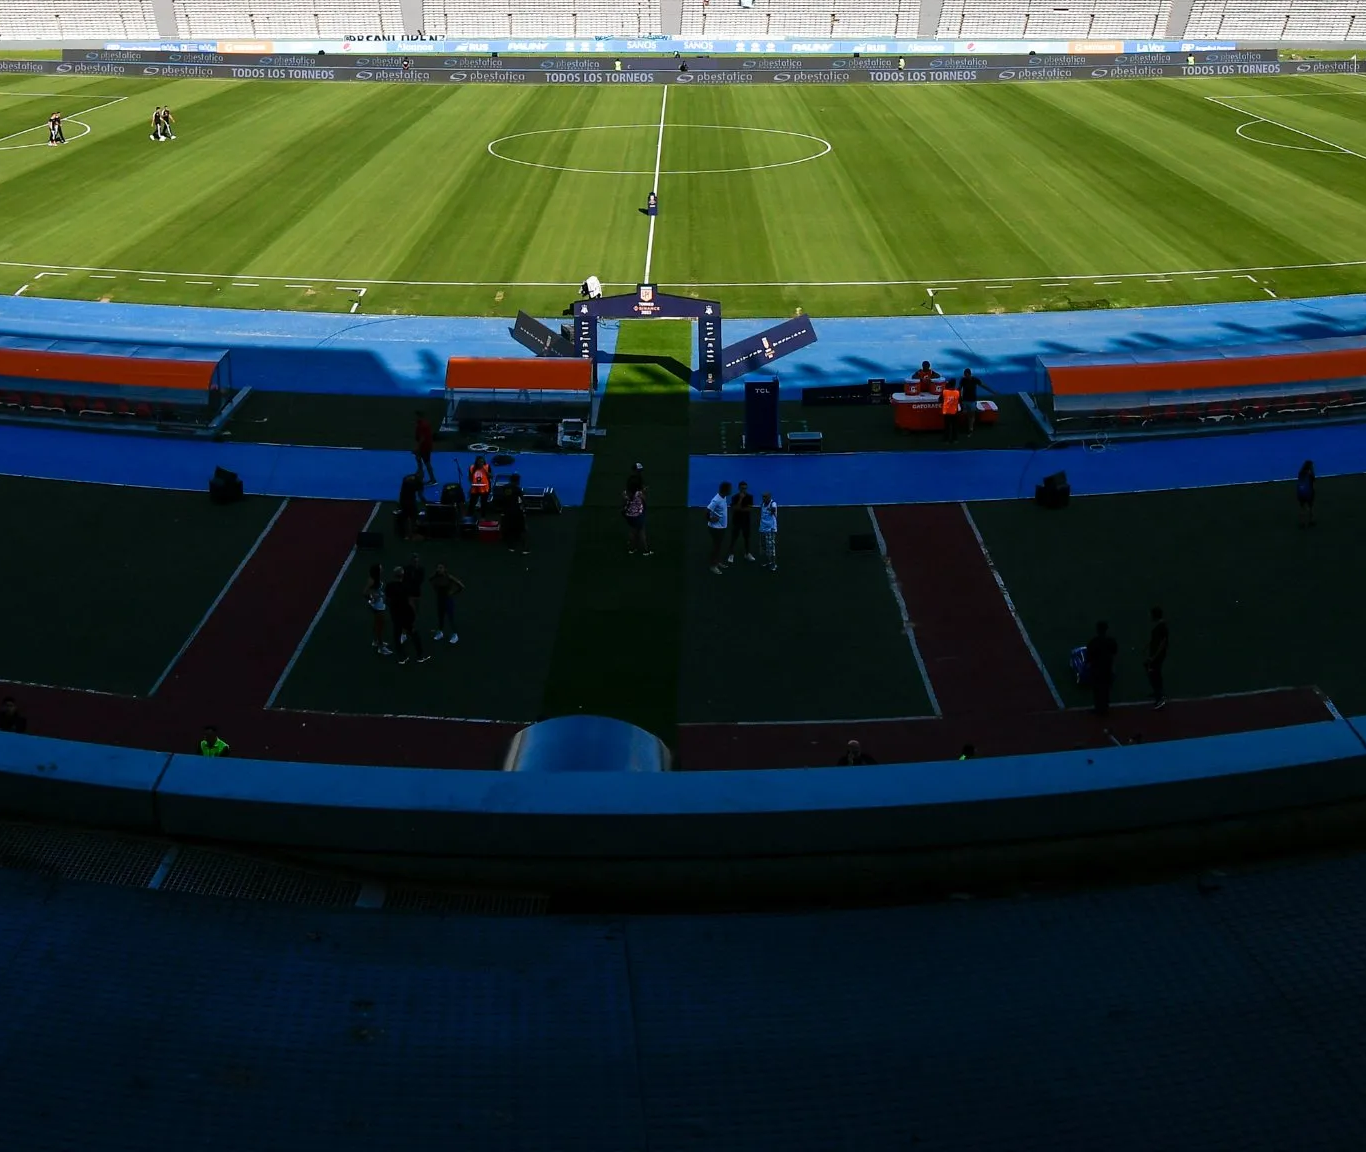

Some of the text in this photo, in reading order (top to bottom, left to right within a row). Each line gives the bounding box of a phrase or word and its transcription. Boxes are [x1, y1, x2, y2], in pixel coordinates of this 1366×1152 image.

[626, 40, 657, 50] SANOS
[683, 40, 714, 50] SANOS
[74, 62, 125, 74] pbestatica
[161, 64, 213, 76] pbestatica
[231, 67, 335, 80] TODOS LOS TORNEOS
[1018, 68, 1072, 79] pbestatica
[1110, 66, 1163, 78] pbestatica
[1181, 62, 1281, 76] TODOS LOS TORNEOS
[374, 69, 430, 81] pbestatica
[469, 71, 526, 83] pbestatica
[545, 72, 654, 84] TODOS LOS TORNEOS
[696, 71, 753, 83] pbestatica
[793, 70, 850, 82] pbestatica
[869, 70, 977, 82] TODOS LOS TORNEOS
[754, 387, 771, 395] TCL
